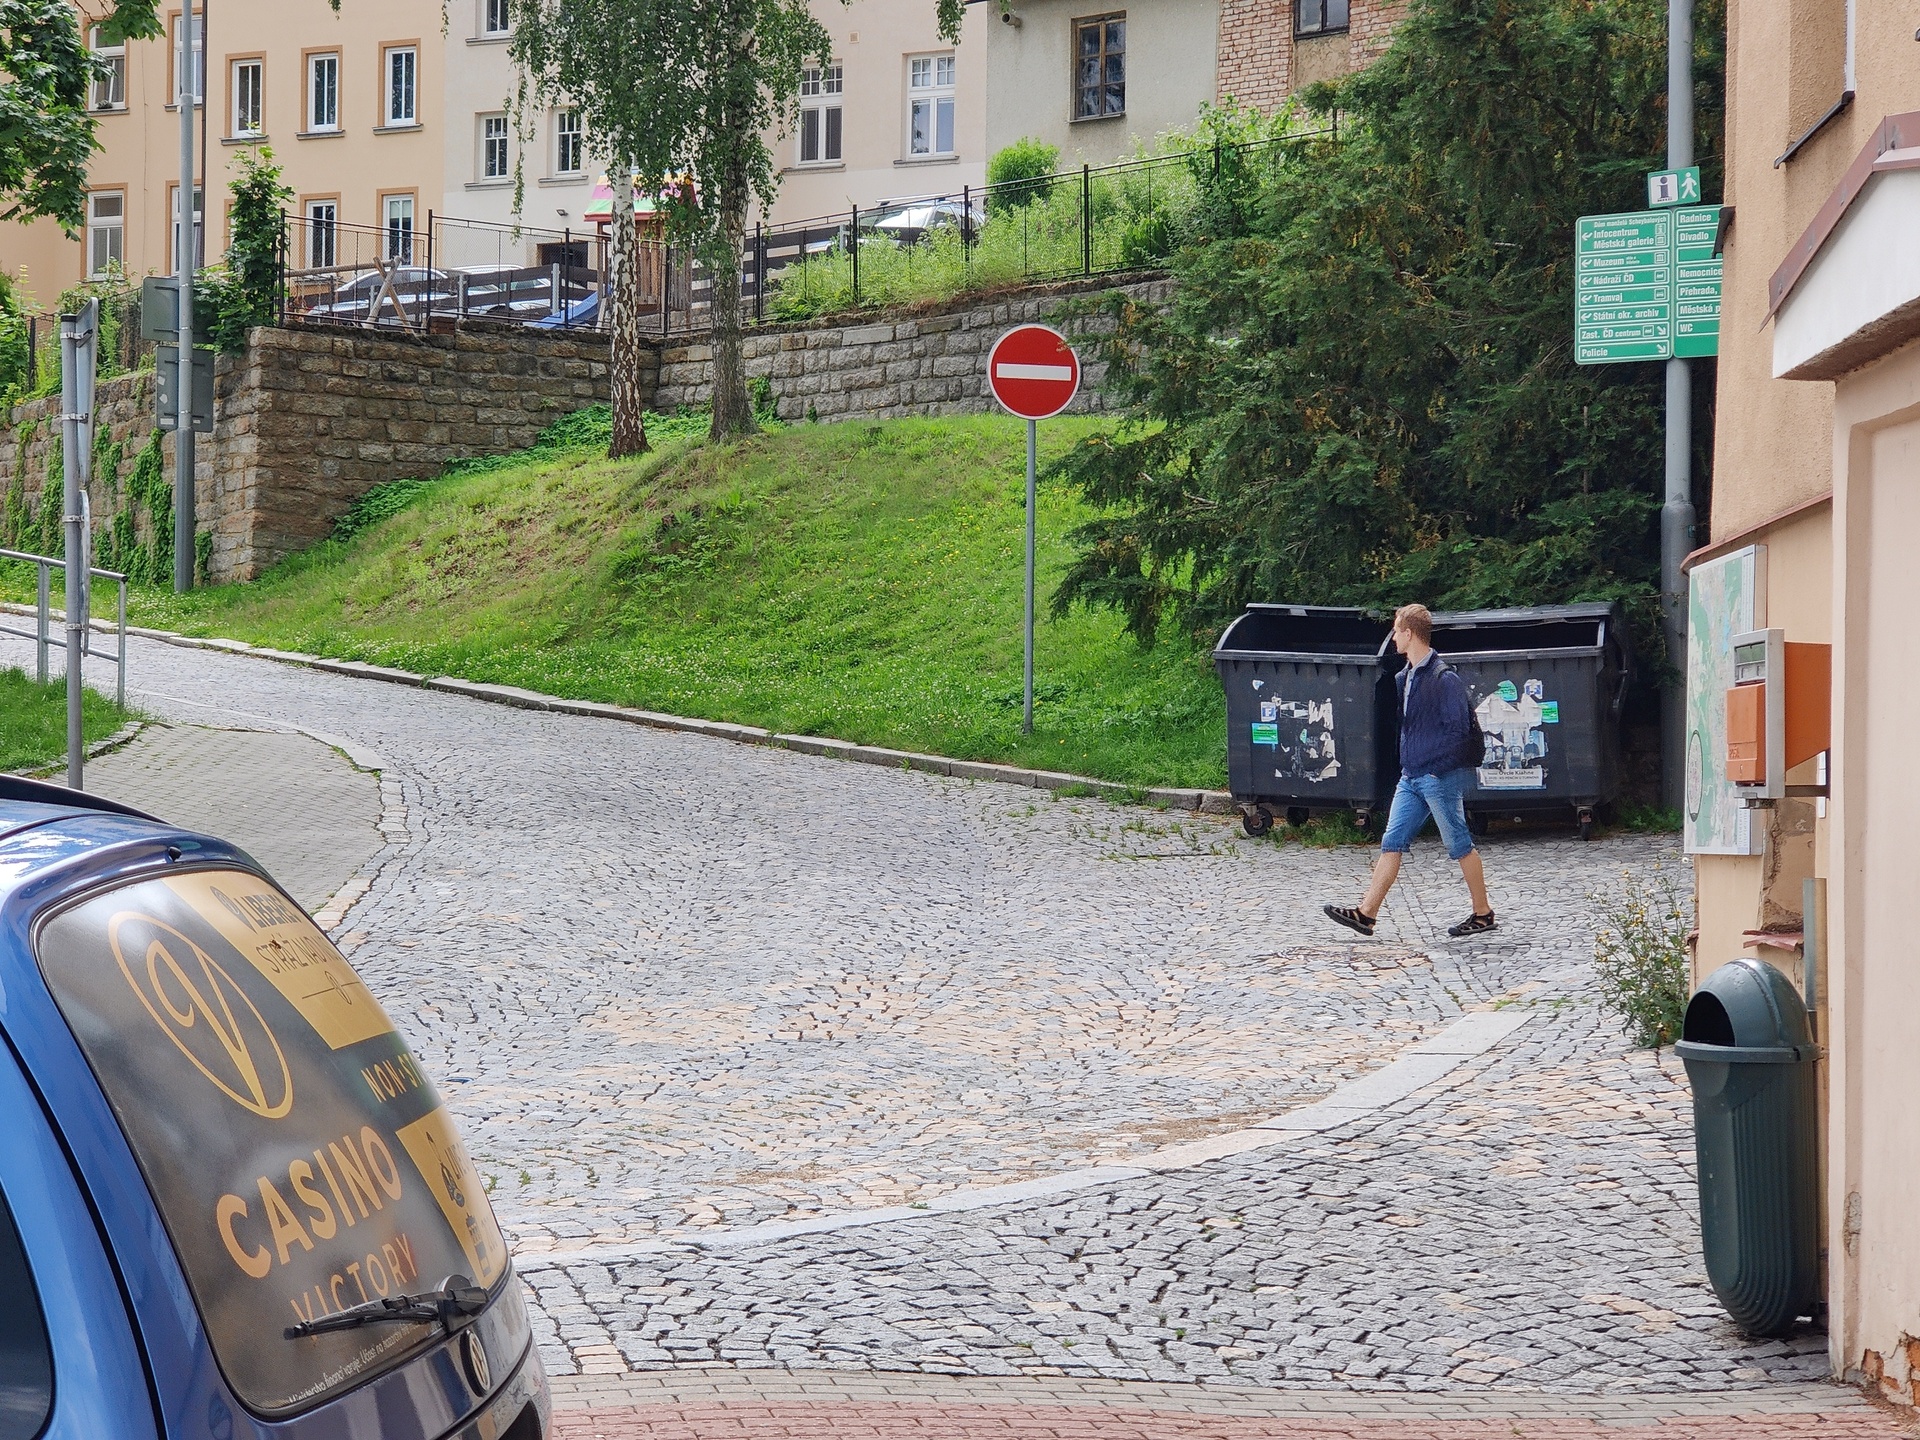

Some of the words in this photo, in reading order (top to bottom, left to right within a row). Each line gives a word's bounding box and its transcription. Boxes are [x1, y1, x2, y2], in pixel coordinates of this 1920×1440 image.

[1680, 213, 1712, 223] Radnice
[1593, 228, 1639, 239] Infocentrum
[1680, 231, 1709, 241] Divadlo
[1593, 238, 1625, 249] Městská
[1627, 237, 1654, 248] galerie
[1593, 257, 1624, 267] Muzeum
[1593, 272, 1621, 285] Nádraží
[1623, 270, 1634, 282] ČD
[1680, 267, 1723, 278] Nemocnice
[1680, 285, 1718, 296] Přehrada,
[1593, 292, 1623, 303] Tramvaj
[1593, 310, 1616, 321] Státní
[1617, 310, 1633, 319] okr.
[1635, 308, 1660, 318] archiv
[1680, 304, 1713, 314] Městská
[1581, 330, 1600, 339] Zast.
[1602, 328, 1613, 338] ČD
[1615, 329, 1641, 337] centrum
[1680, 323, 1693, 333] WC
[1581, 347, 1608, 357] Policie
[216, 1125, 402, 1279] CASINO
[290, 1233, 417, 1341] VICTORY
